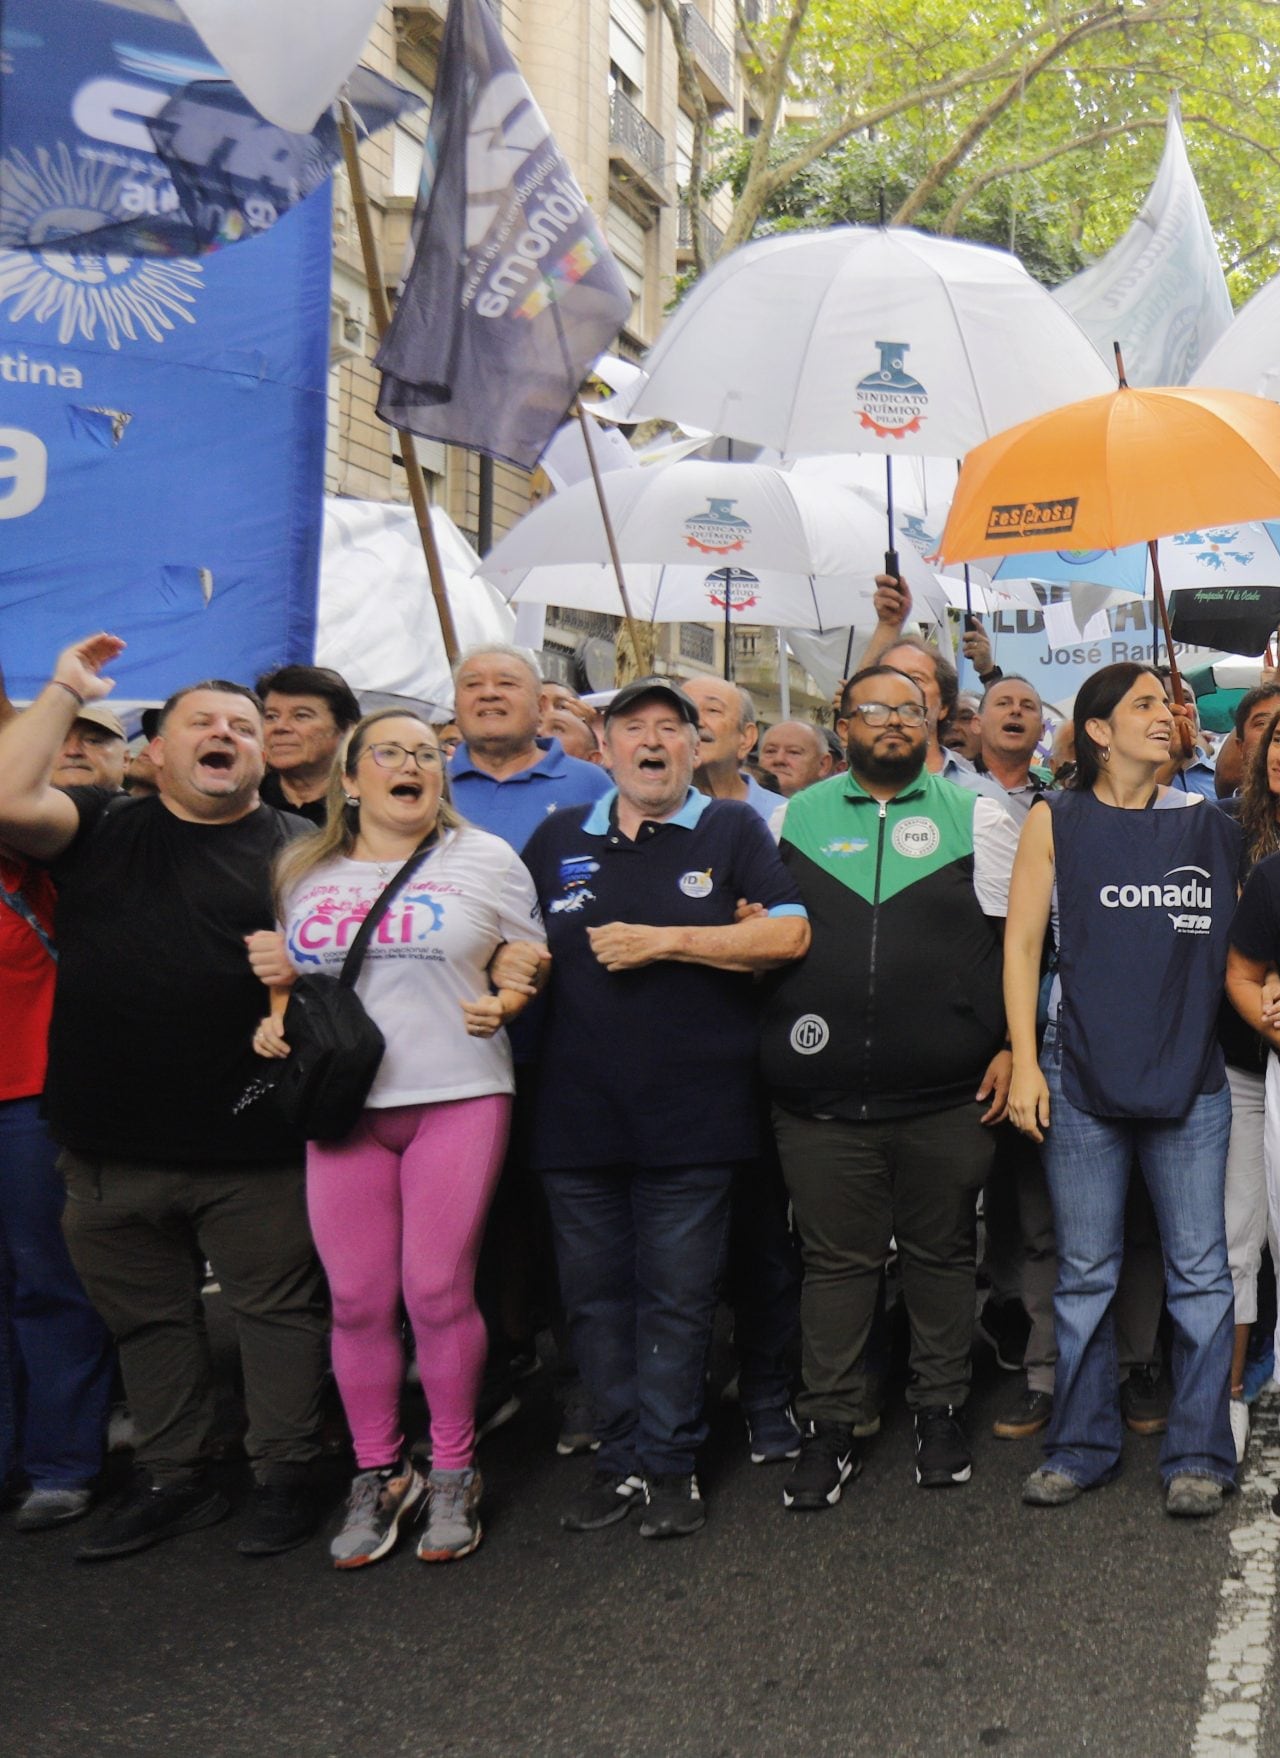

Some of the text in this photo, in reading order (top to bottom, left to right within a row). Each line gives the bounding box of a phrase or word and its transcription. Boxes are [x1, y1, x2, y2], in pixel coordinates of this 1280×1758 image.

[856, 391, 928, 405] SINDICATO
[863, 403, 921, 416] QUÍMICO
[876, 415, 904, 424] PILAR
[1040, 642, 1101, 665] José
[905, 832, 929, 842] FGB
[1100, 879, 1212, 908] conadu
